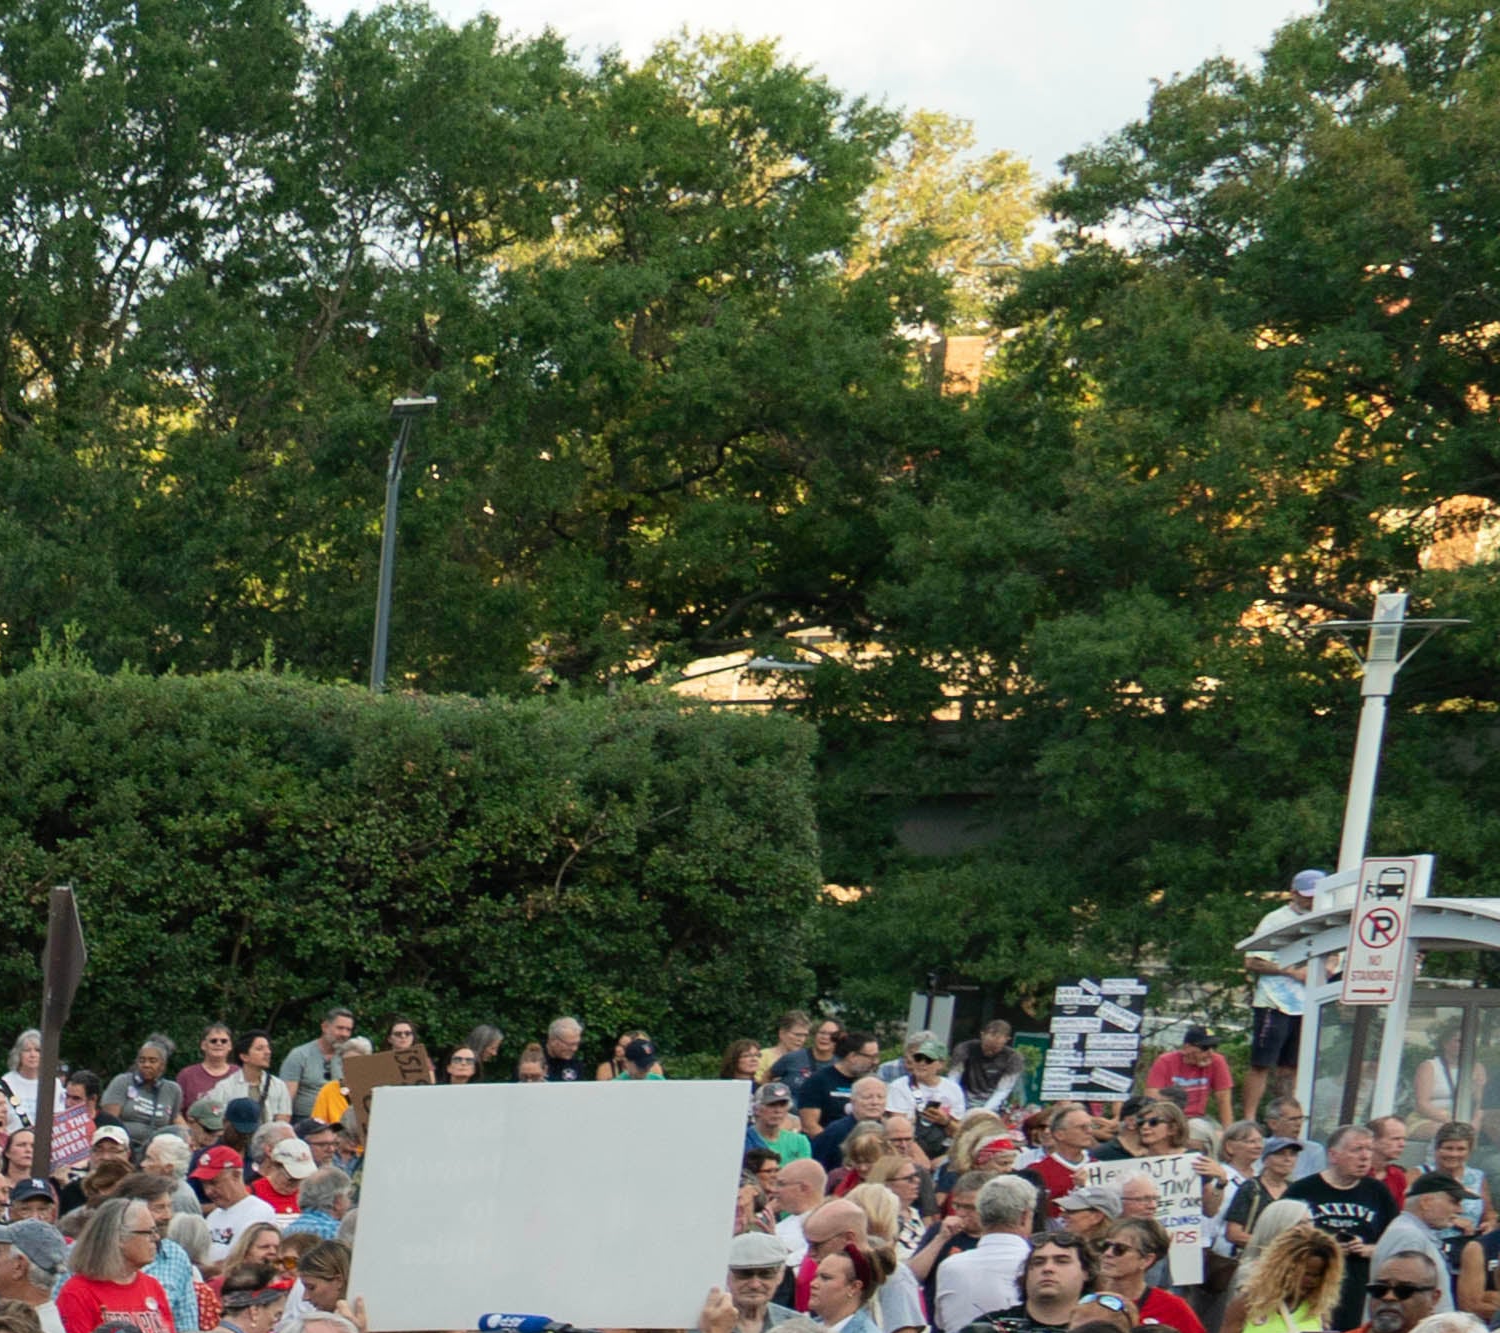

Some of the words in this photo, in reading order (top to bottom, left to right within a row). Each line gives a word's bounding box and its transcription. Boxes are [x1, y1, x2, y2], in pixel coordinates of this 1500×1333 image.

[1369, 954, 1382, 966] NO
[1351, 969, 1395, 982] STANDING
[51, 1126, 87, 1149] NNEDY
[52, 1137, 90, 1161] ENTER!
[1161, 1177, 1196, 1196] TINY
